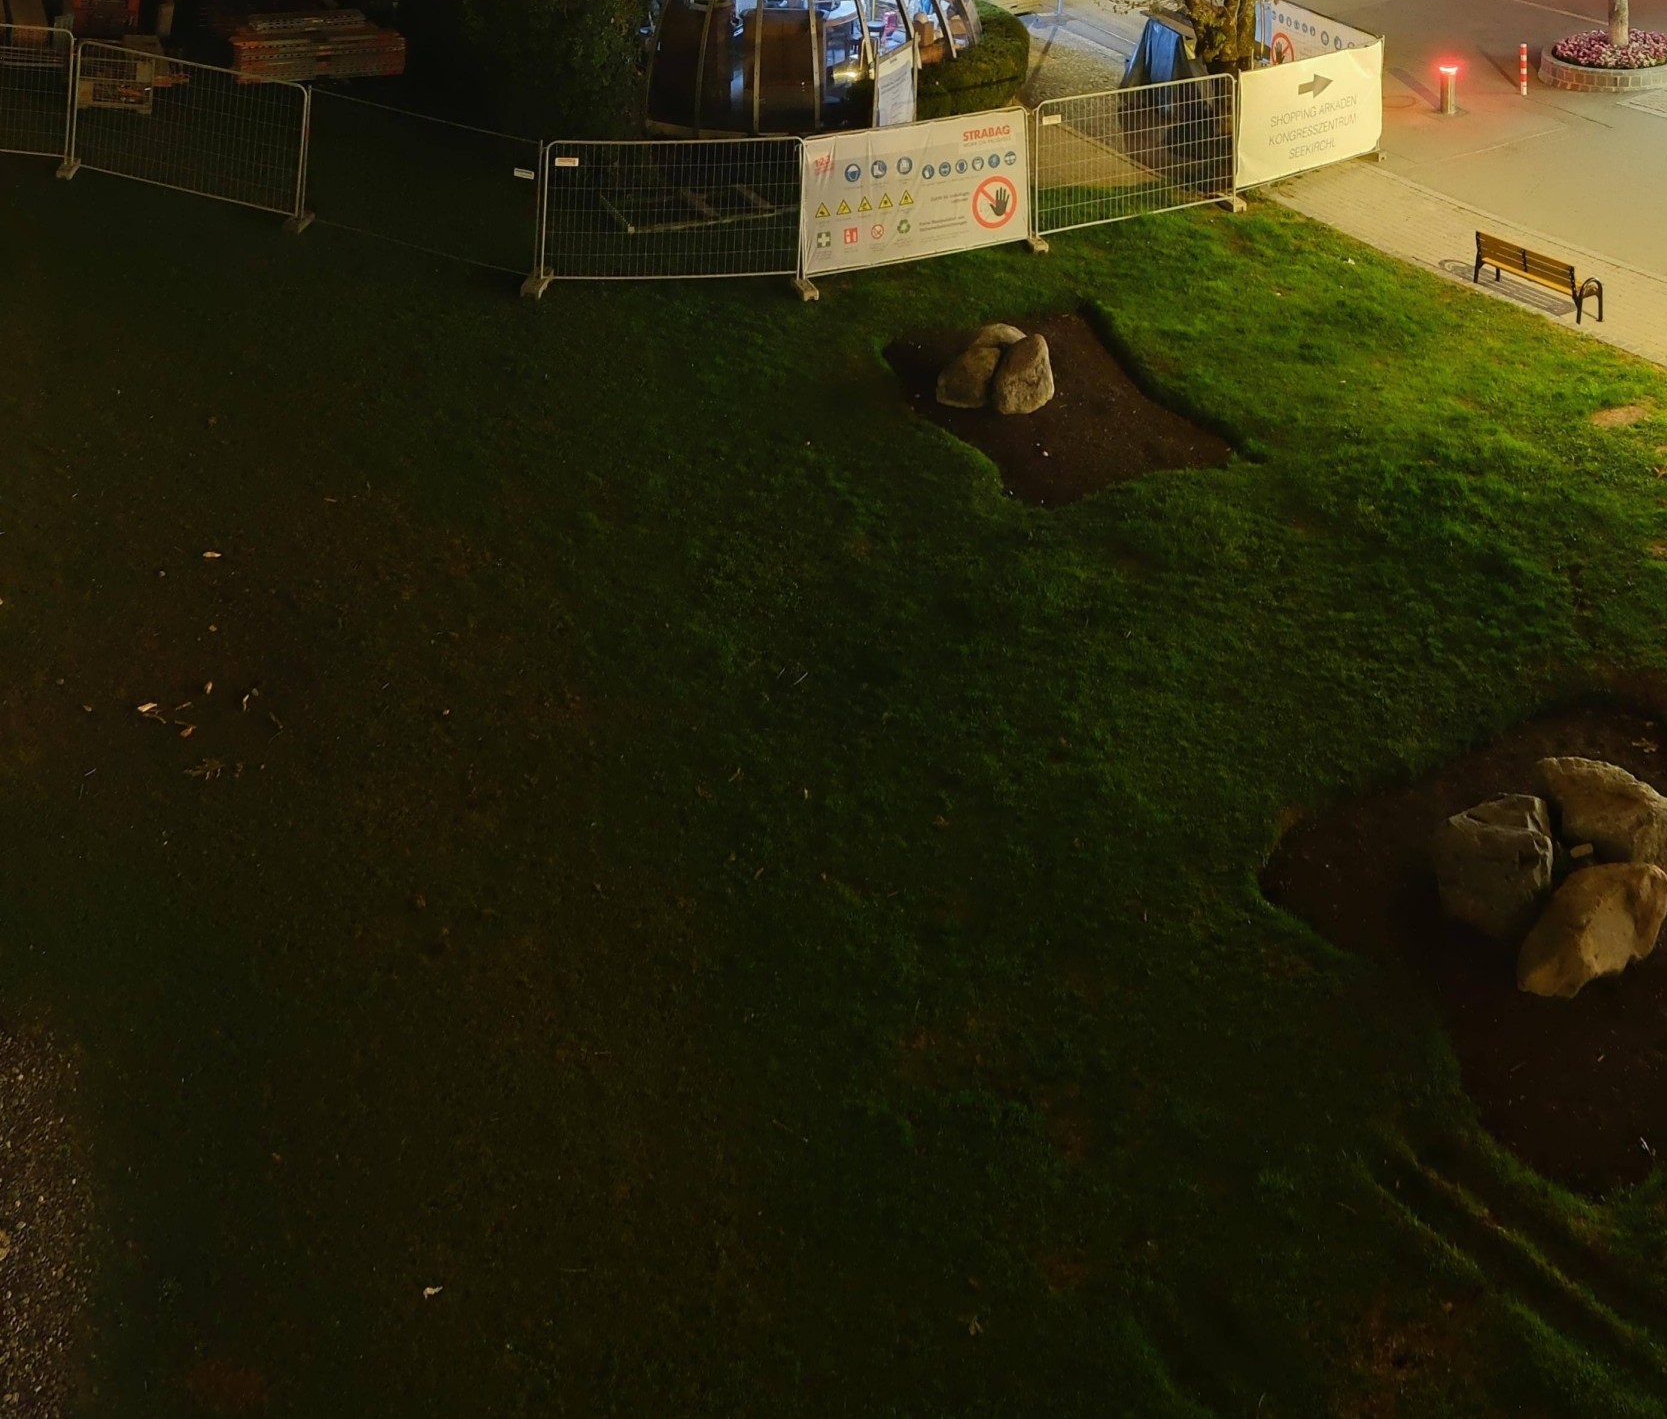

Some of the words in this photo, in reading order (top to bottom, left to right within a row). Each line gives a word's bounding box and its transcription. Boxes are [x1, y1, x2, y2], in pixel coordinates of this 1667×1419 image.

[1270, 106, 1317, 128] SHOPPING
[1318, 94, 1357, 115] ARKADEN
[962, 124, 1010, 142] STRABAG
[1268, 113, 1357, 146] KONGRESSZENTRUM
[1289, 139, 1336, 160] SEEKIRCHL
